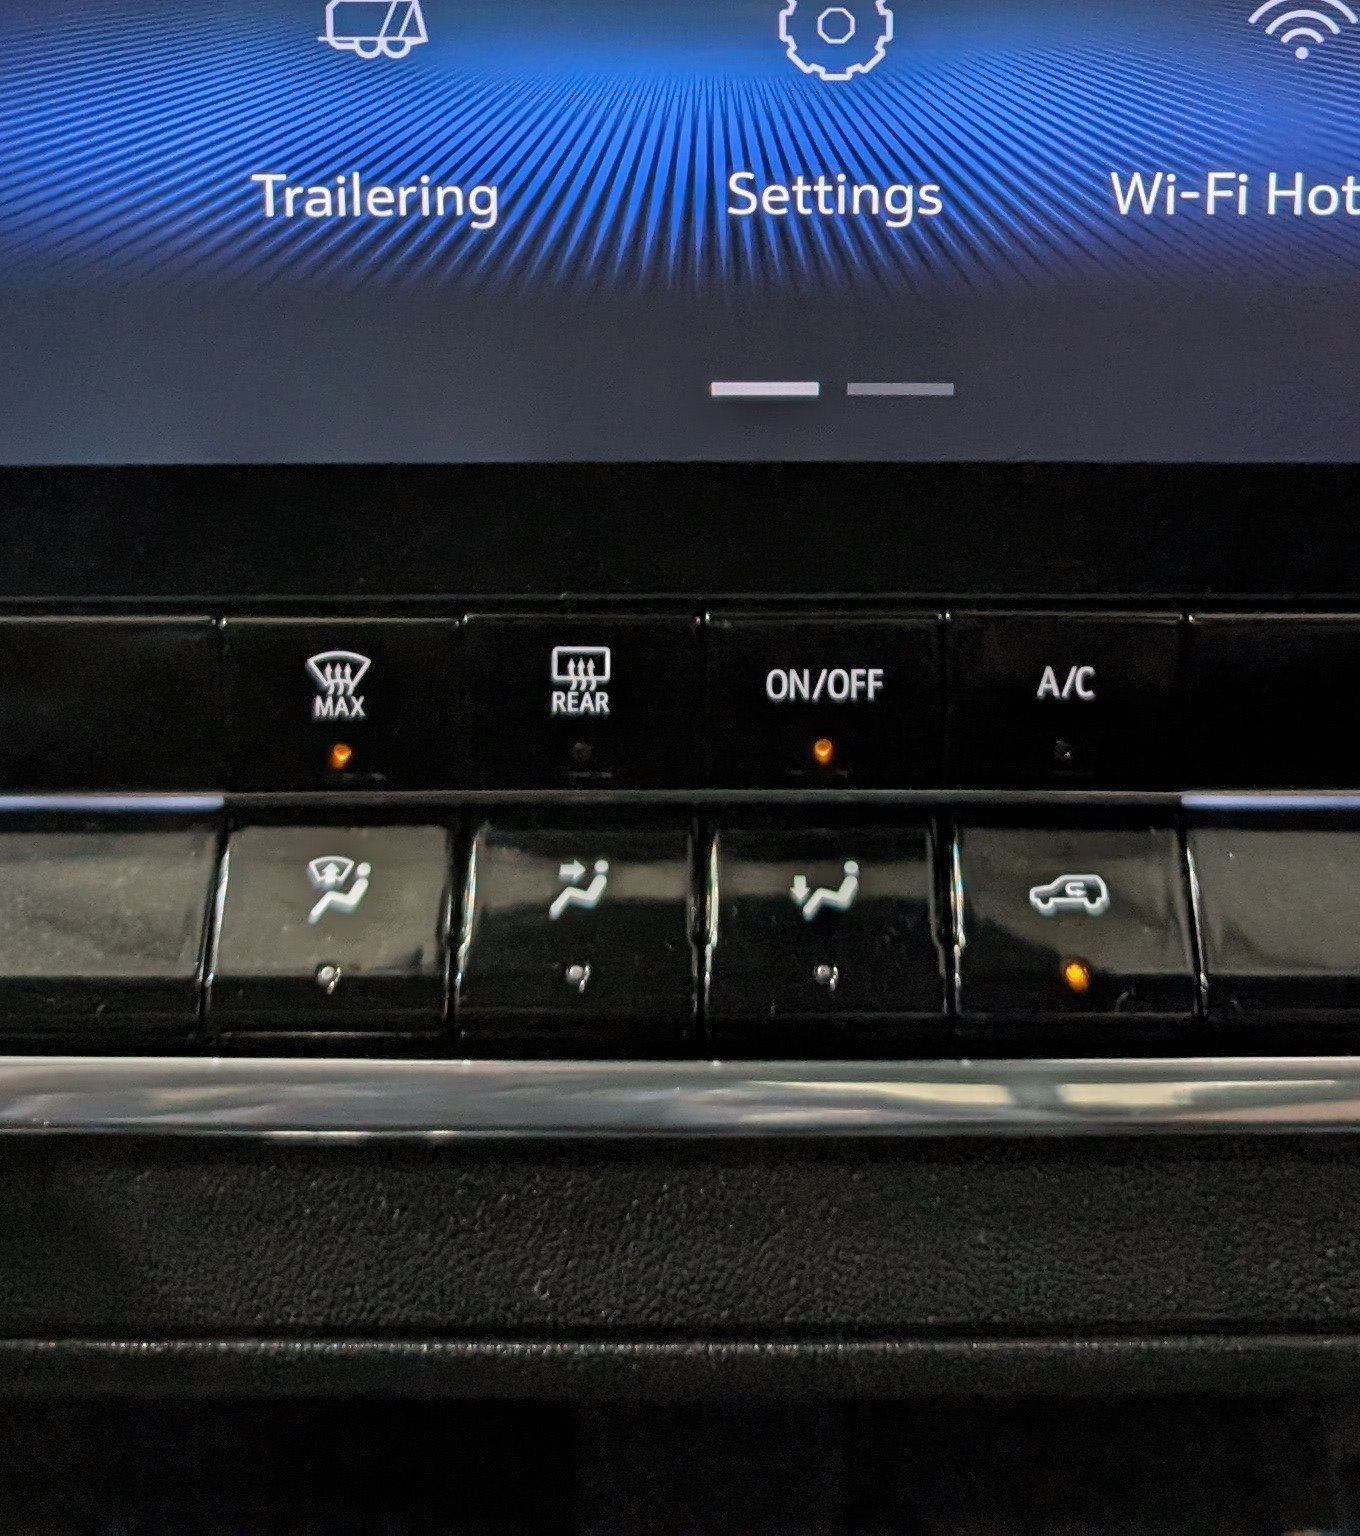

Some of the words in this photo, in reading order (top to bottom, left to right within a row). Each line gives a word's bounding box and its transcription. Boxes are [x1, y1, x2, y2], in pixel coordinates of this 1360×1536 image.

[250, 171, 500, 232] Trailering
[727, 171, 945, 230] Settings
[1110, 171, 1251, 218] Wi-Fi
[765, 668, 886, 702] ON/OFF
[1036, 665, 1097, 701] A/C
[314, 694, 366, 720] MAX
[550, 690, 610, 716] REAR
